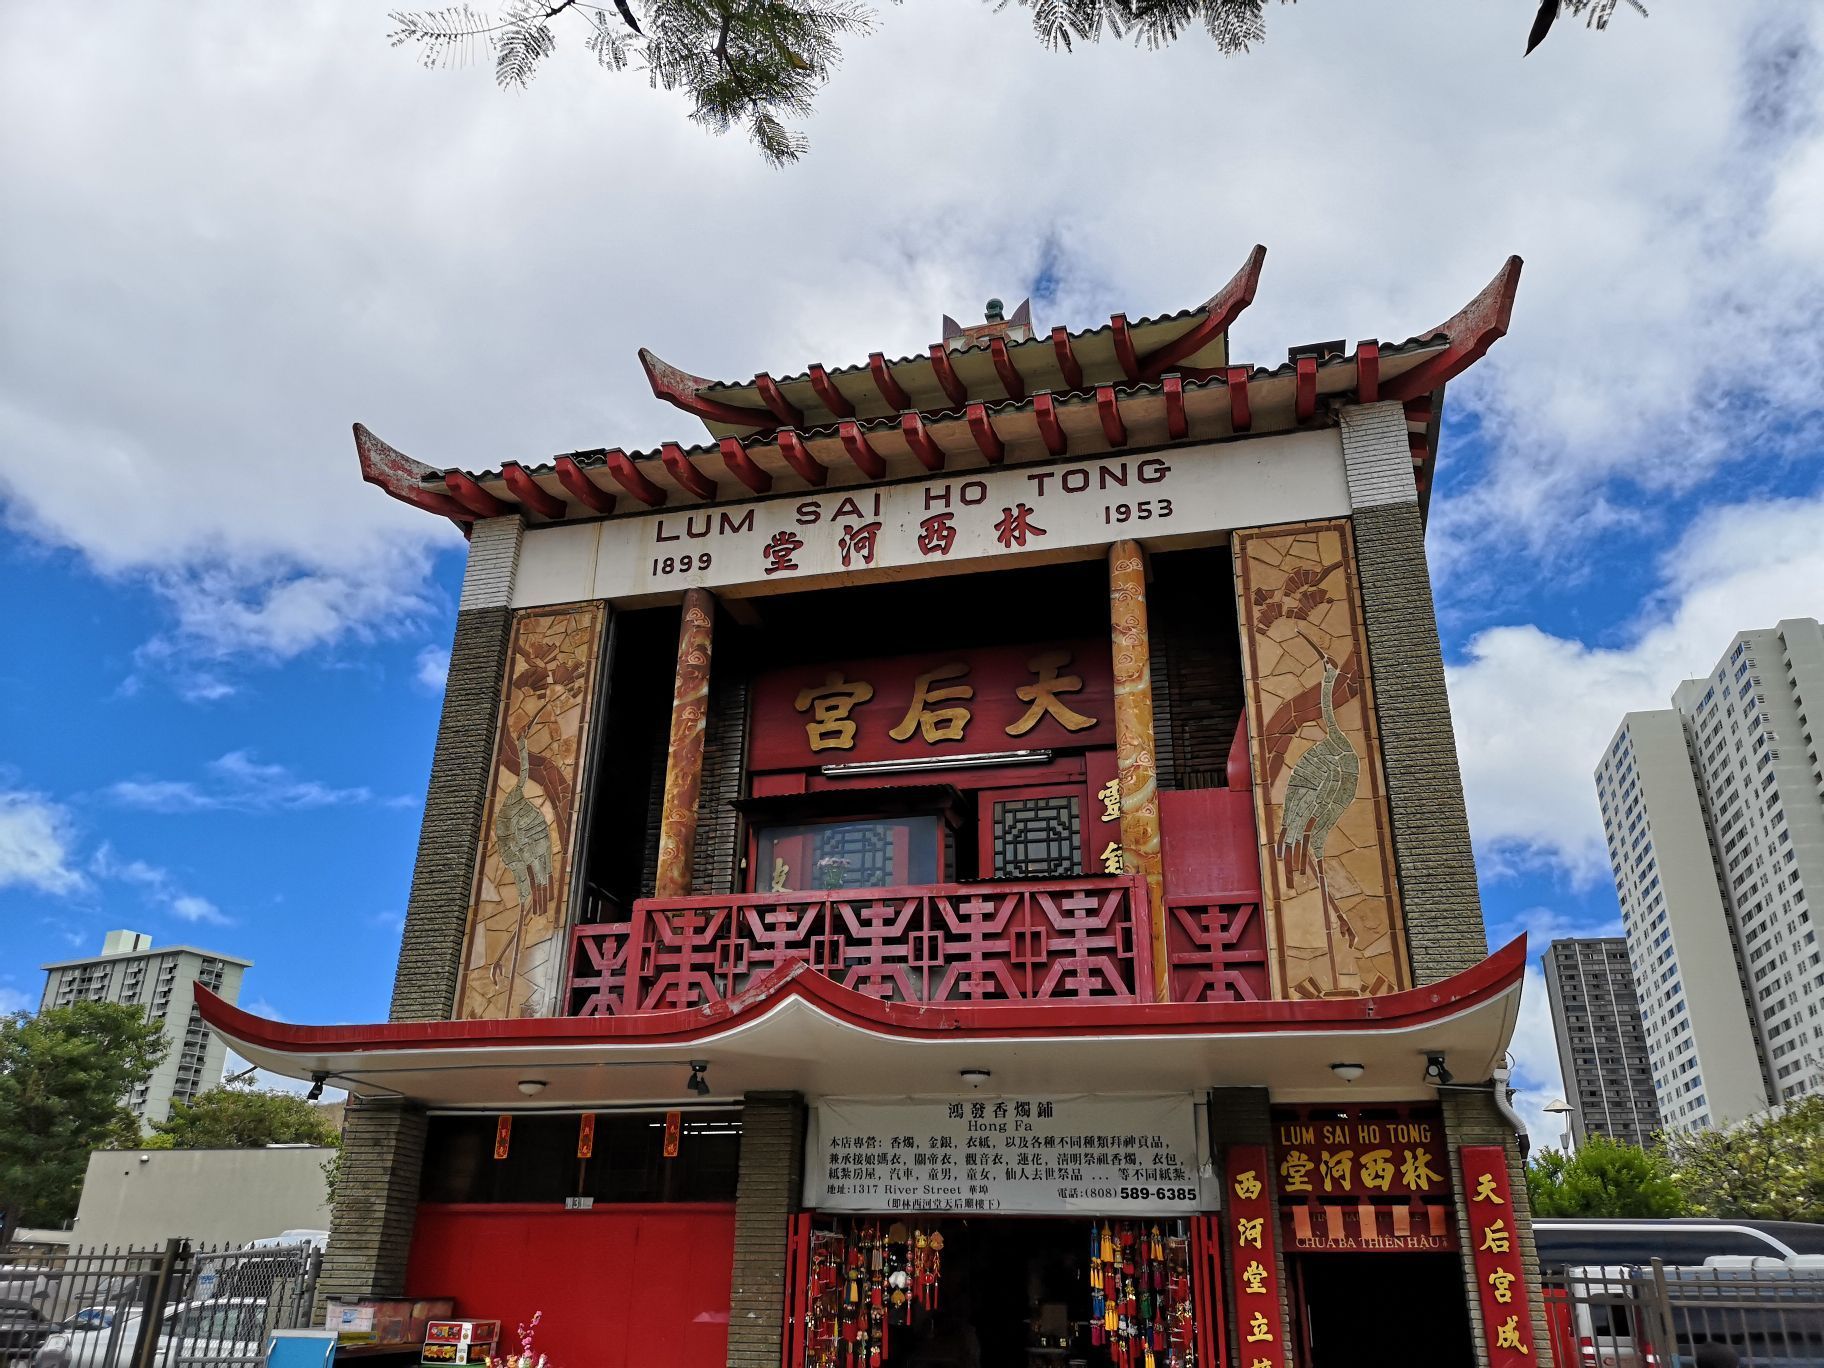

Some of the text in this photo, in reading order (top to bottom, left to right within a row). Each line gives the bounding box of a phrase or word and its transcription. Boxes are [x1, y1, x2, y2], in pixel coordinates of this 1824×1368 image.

[656, 458, 1172, 543] LUM SAI HO TONG
[1104, 499, 1174, 525] 1953
[652, 552, 713, 577] 1899
[967, 1119, 1033, 1133] Hong Fa
[1281, 1124, 1431, 1146] LUM SAI HO TONG
[884, 1184, 919, 1196] River
[923, 1184, 962, 1196] Street
[1120, 1186, 1198, 1201] 589-6385
